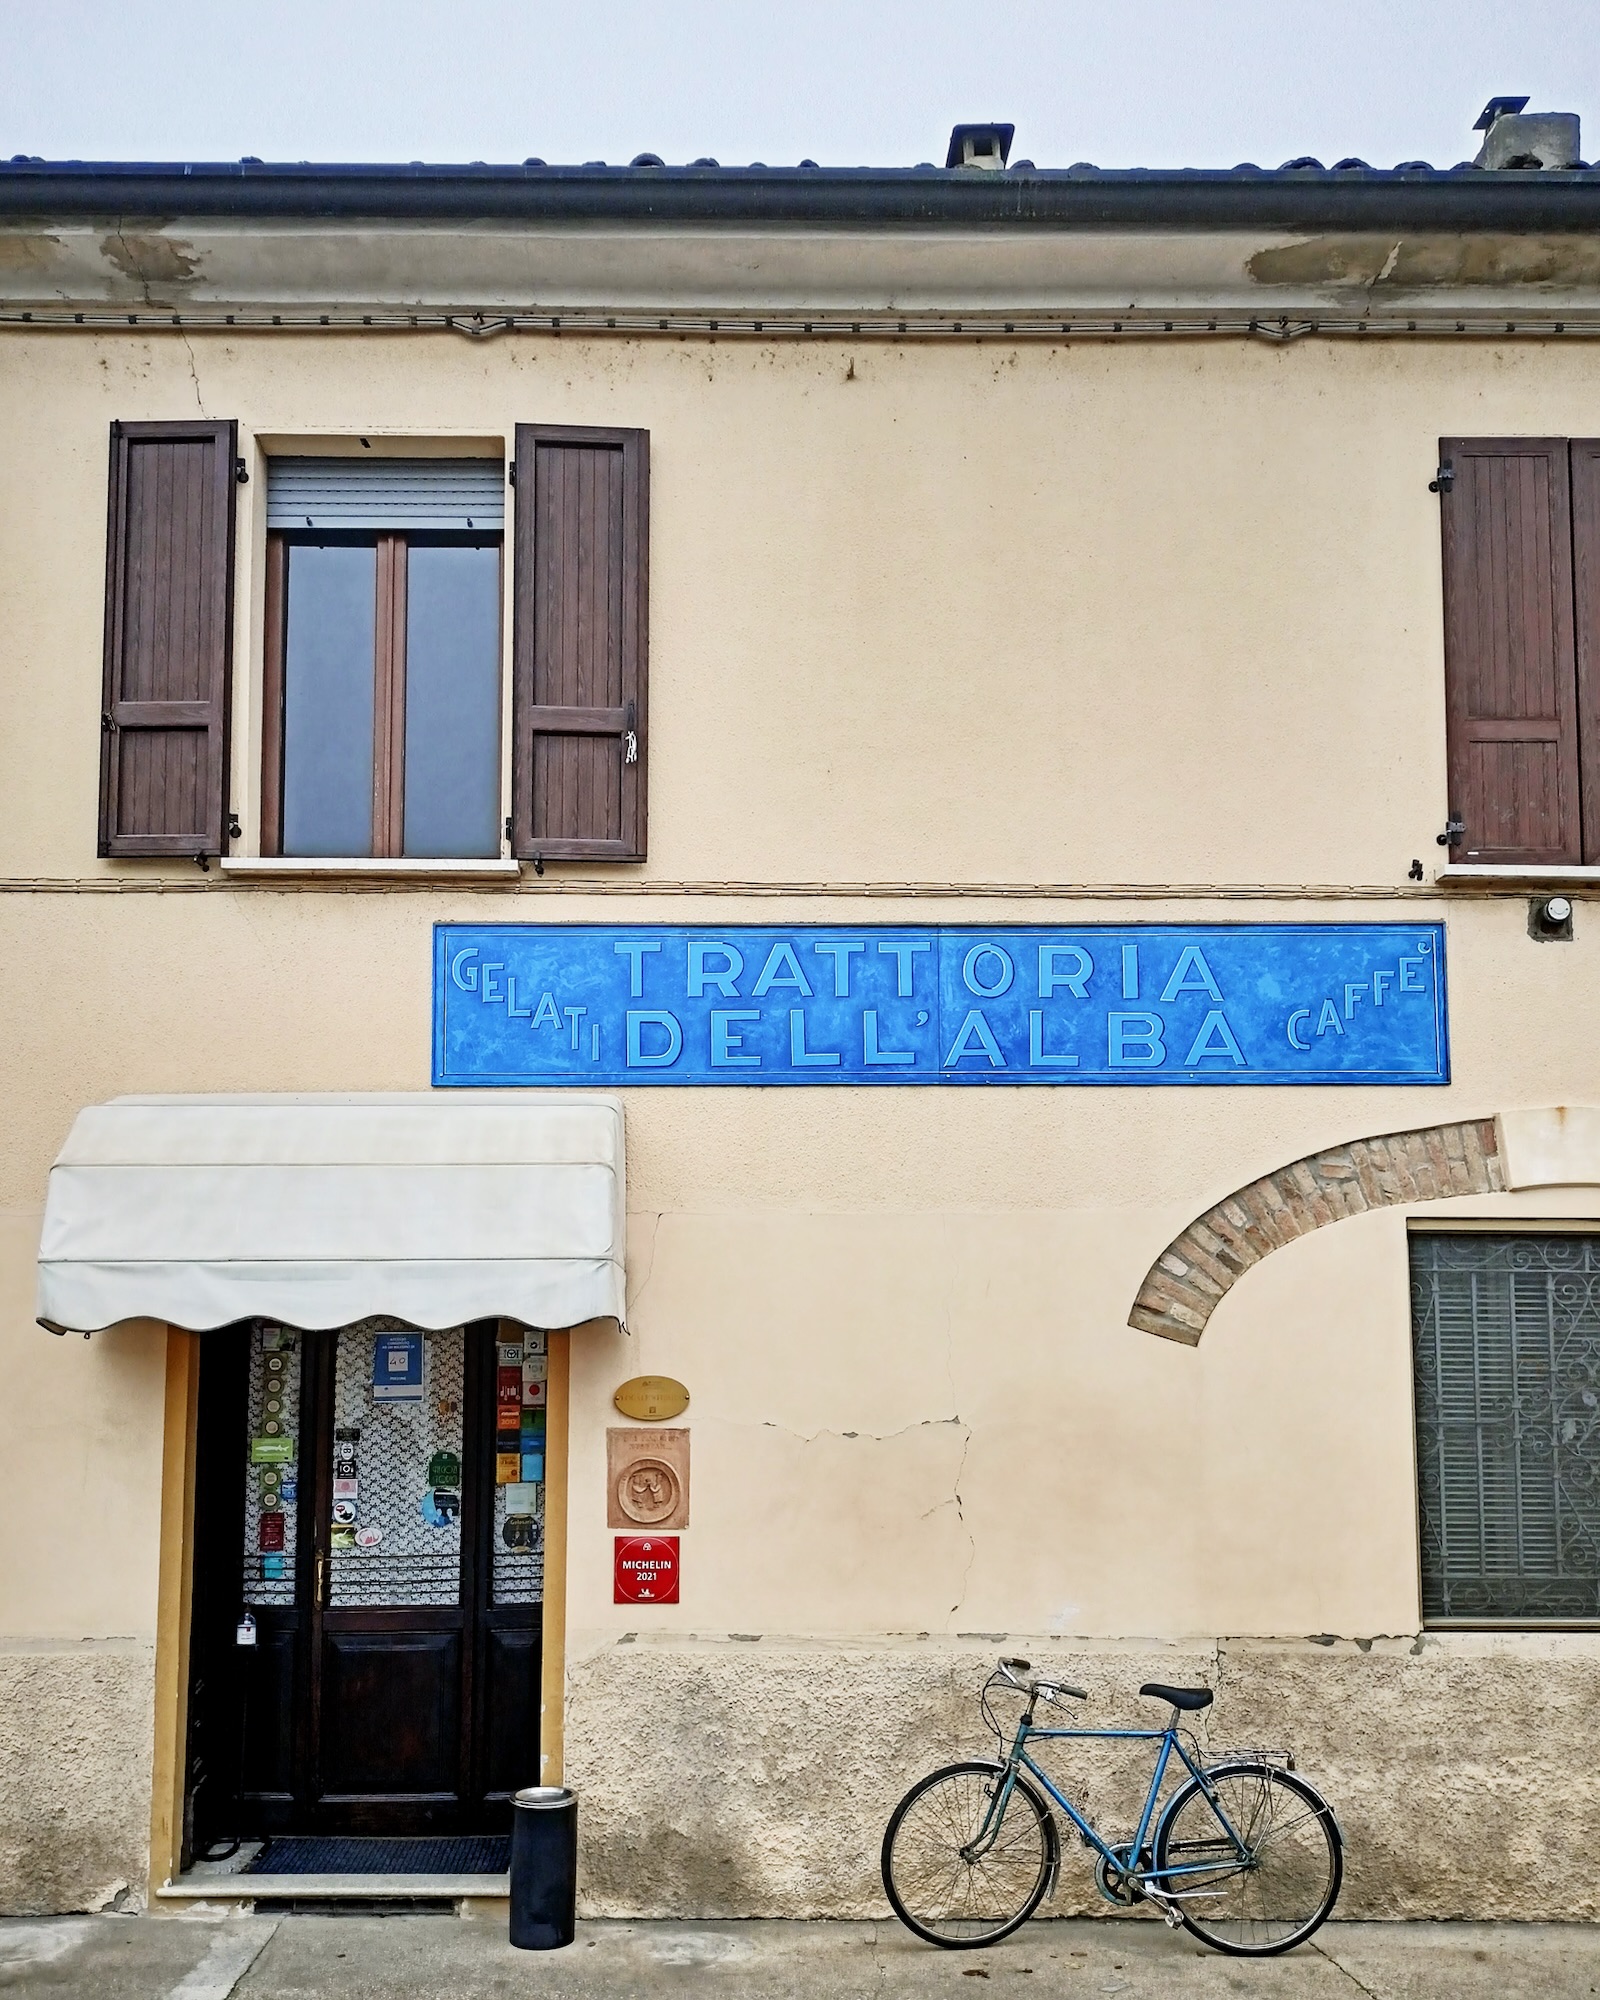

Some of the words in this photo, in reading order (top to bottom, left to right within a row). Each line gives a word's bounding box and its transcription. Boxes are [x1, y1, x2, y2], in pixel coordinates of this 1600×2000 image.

[614, 941, 1224, 1002] TRATTORIA
[451, 947, 600, 1061] GELATI
[389, 1356, 406, 1366] 40
[622, 1560, 672, 1570] MICHELIN
[636, 1572, 657, 1581] 2021
